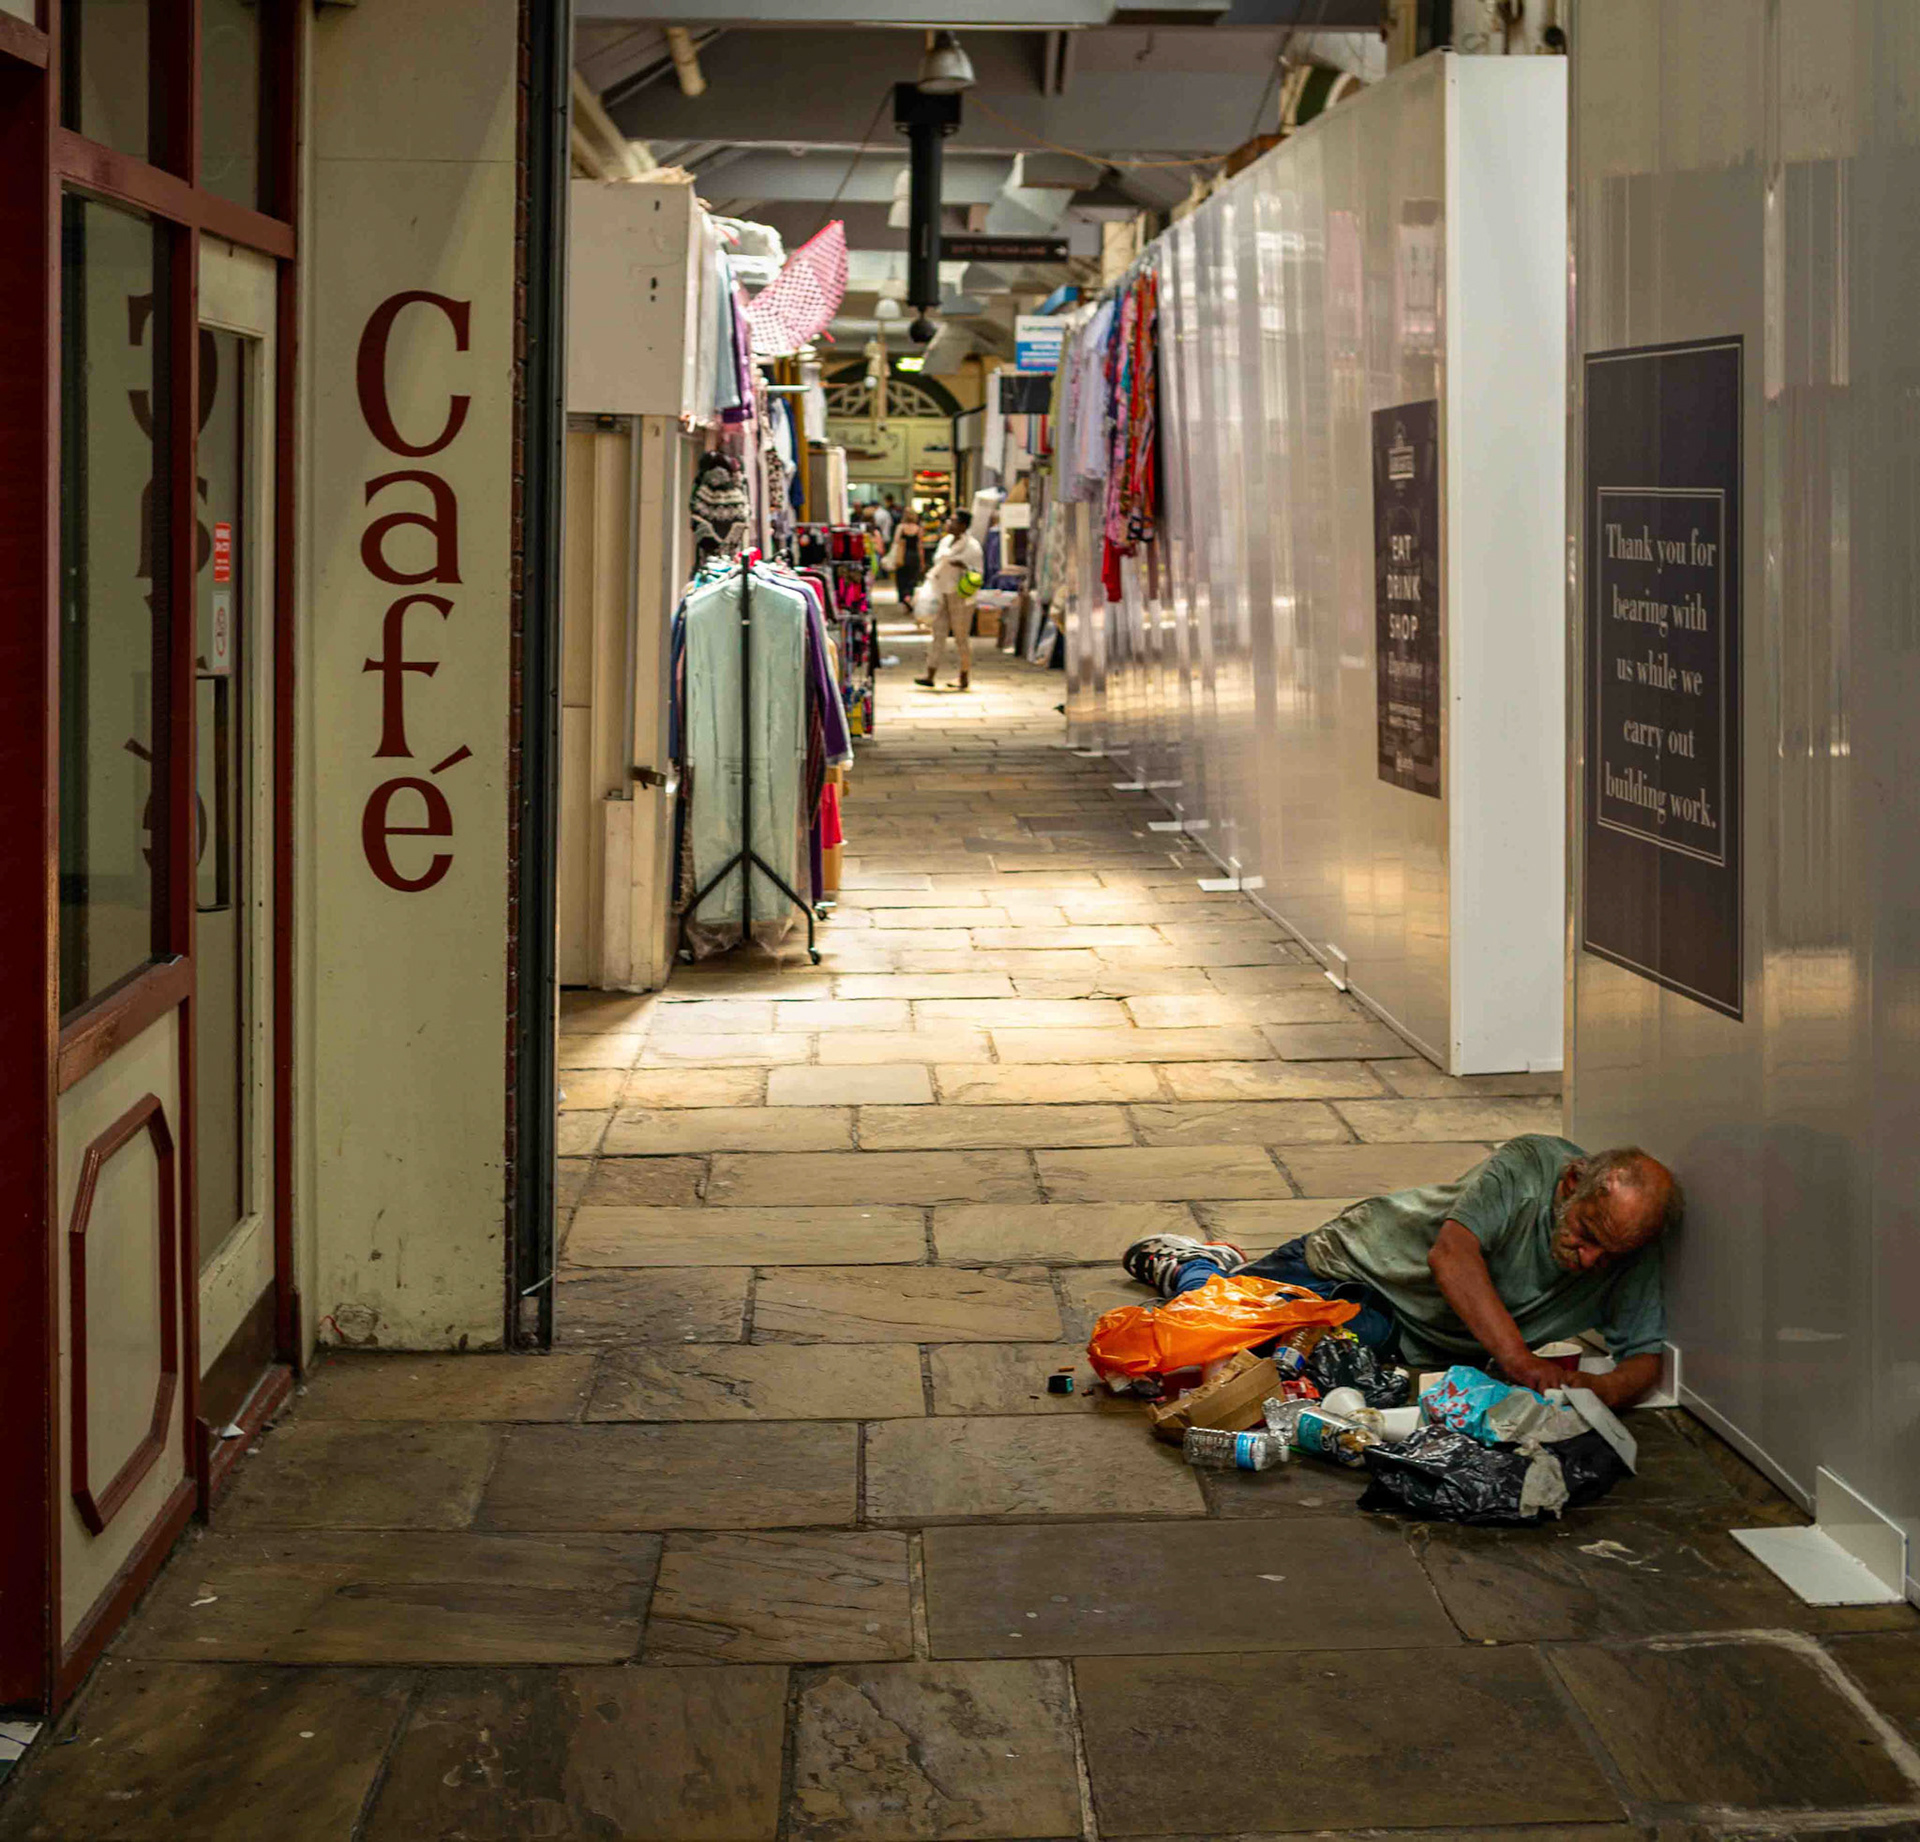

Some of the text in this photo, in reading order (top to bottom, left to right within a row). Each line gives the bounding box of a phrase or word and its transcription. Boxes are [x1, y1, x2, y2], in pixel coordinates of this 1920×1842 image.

[1392, 535, 1411, 561] EAT
[1605, 523, 1717, 574] Thank you for
[356, 290, 474, 893] Café
[1387, 574, 1421, 601] DRINK
[1613, 583, 1708, 638] bearing with
[1389, 613, 1419, 640] SHOP
[1617, 649, 1704, 696] us while we
[1623, 719, 1696, 761] carry out
[1605, 760, 1717, 829] building work.
